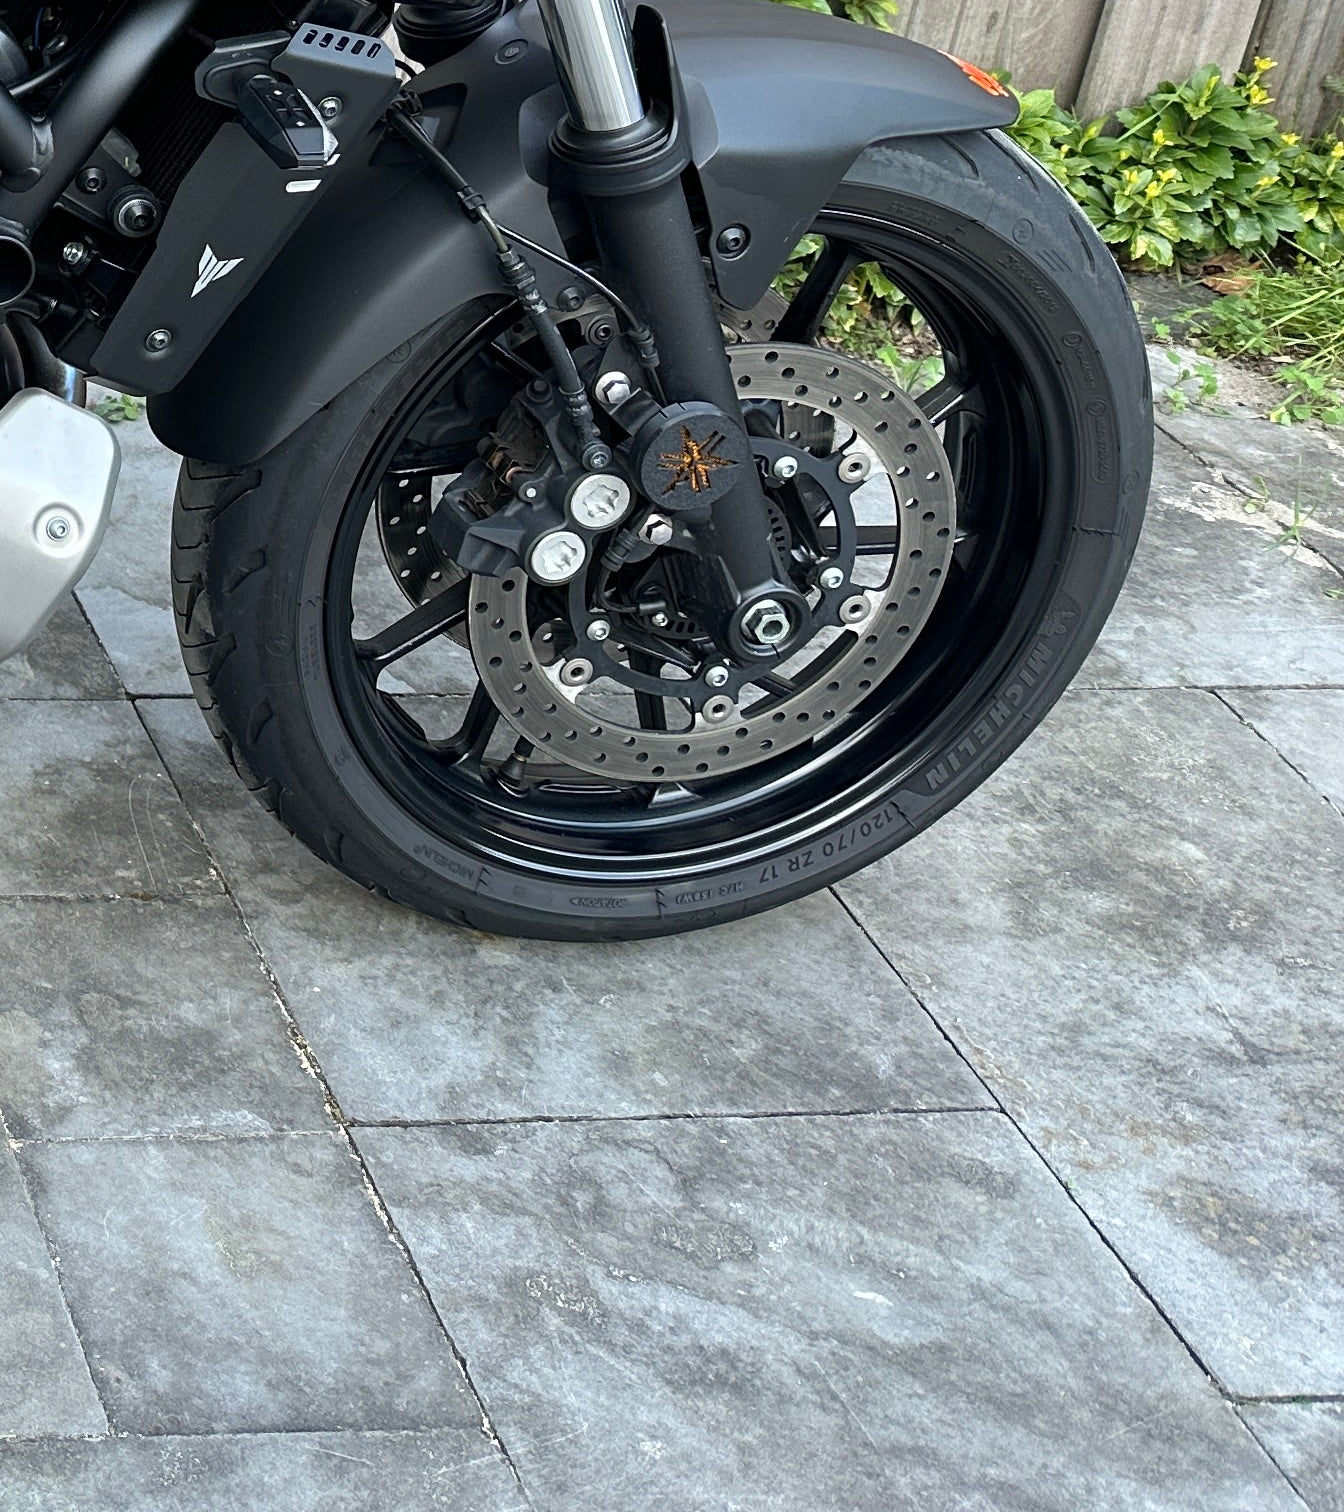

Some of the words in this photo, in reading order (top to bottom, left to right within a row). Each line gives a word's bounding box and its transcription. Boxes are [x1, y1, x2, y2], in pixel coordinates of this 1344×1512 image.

[925, 644, 1055, 790] MICHELIN
[822, 807, 894, 858] 120/70
[760, 865, 780, 884] 17
[789, 850, 815, 872] ZR
